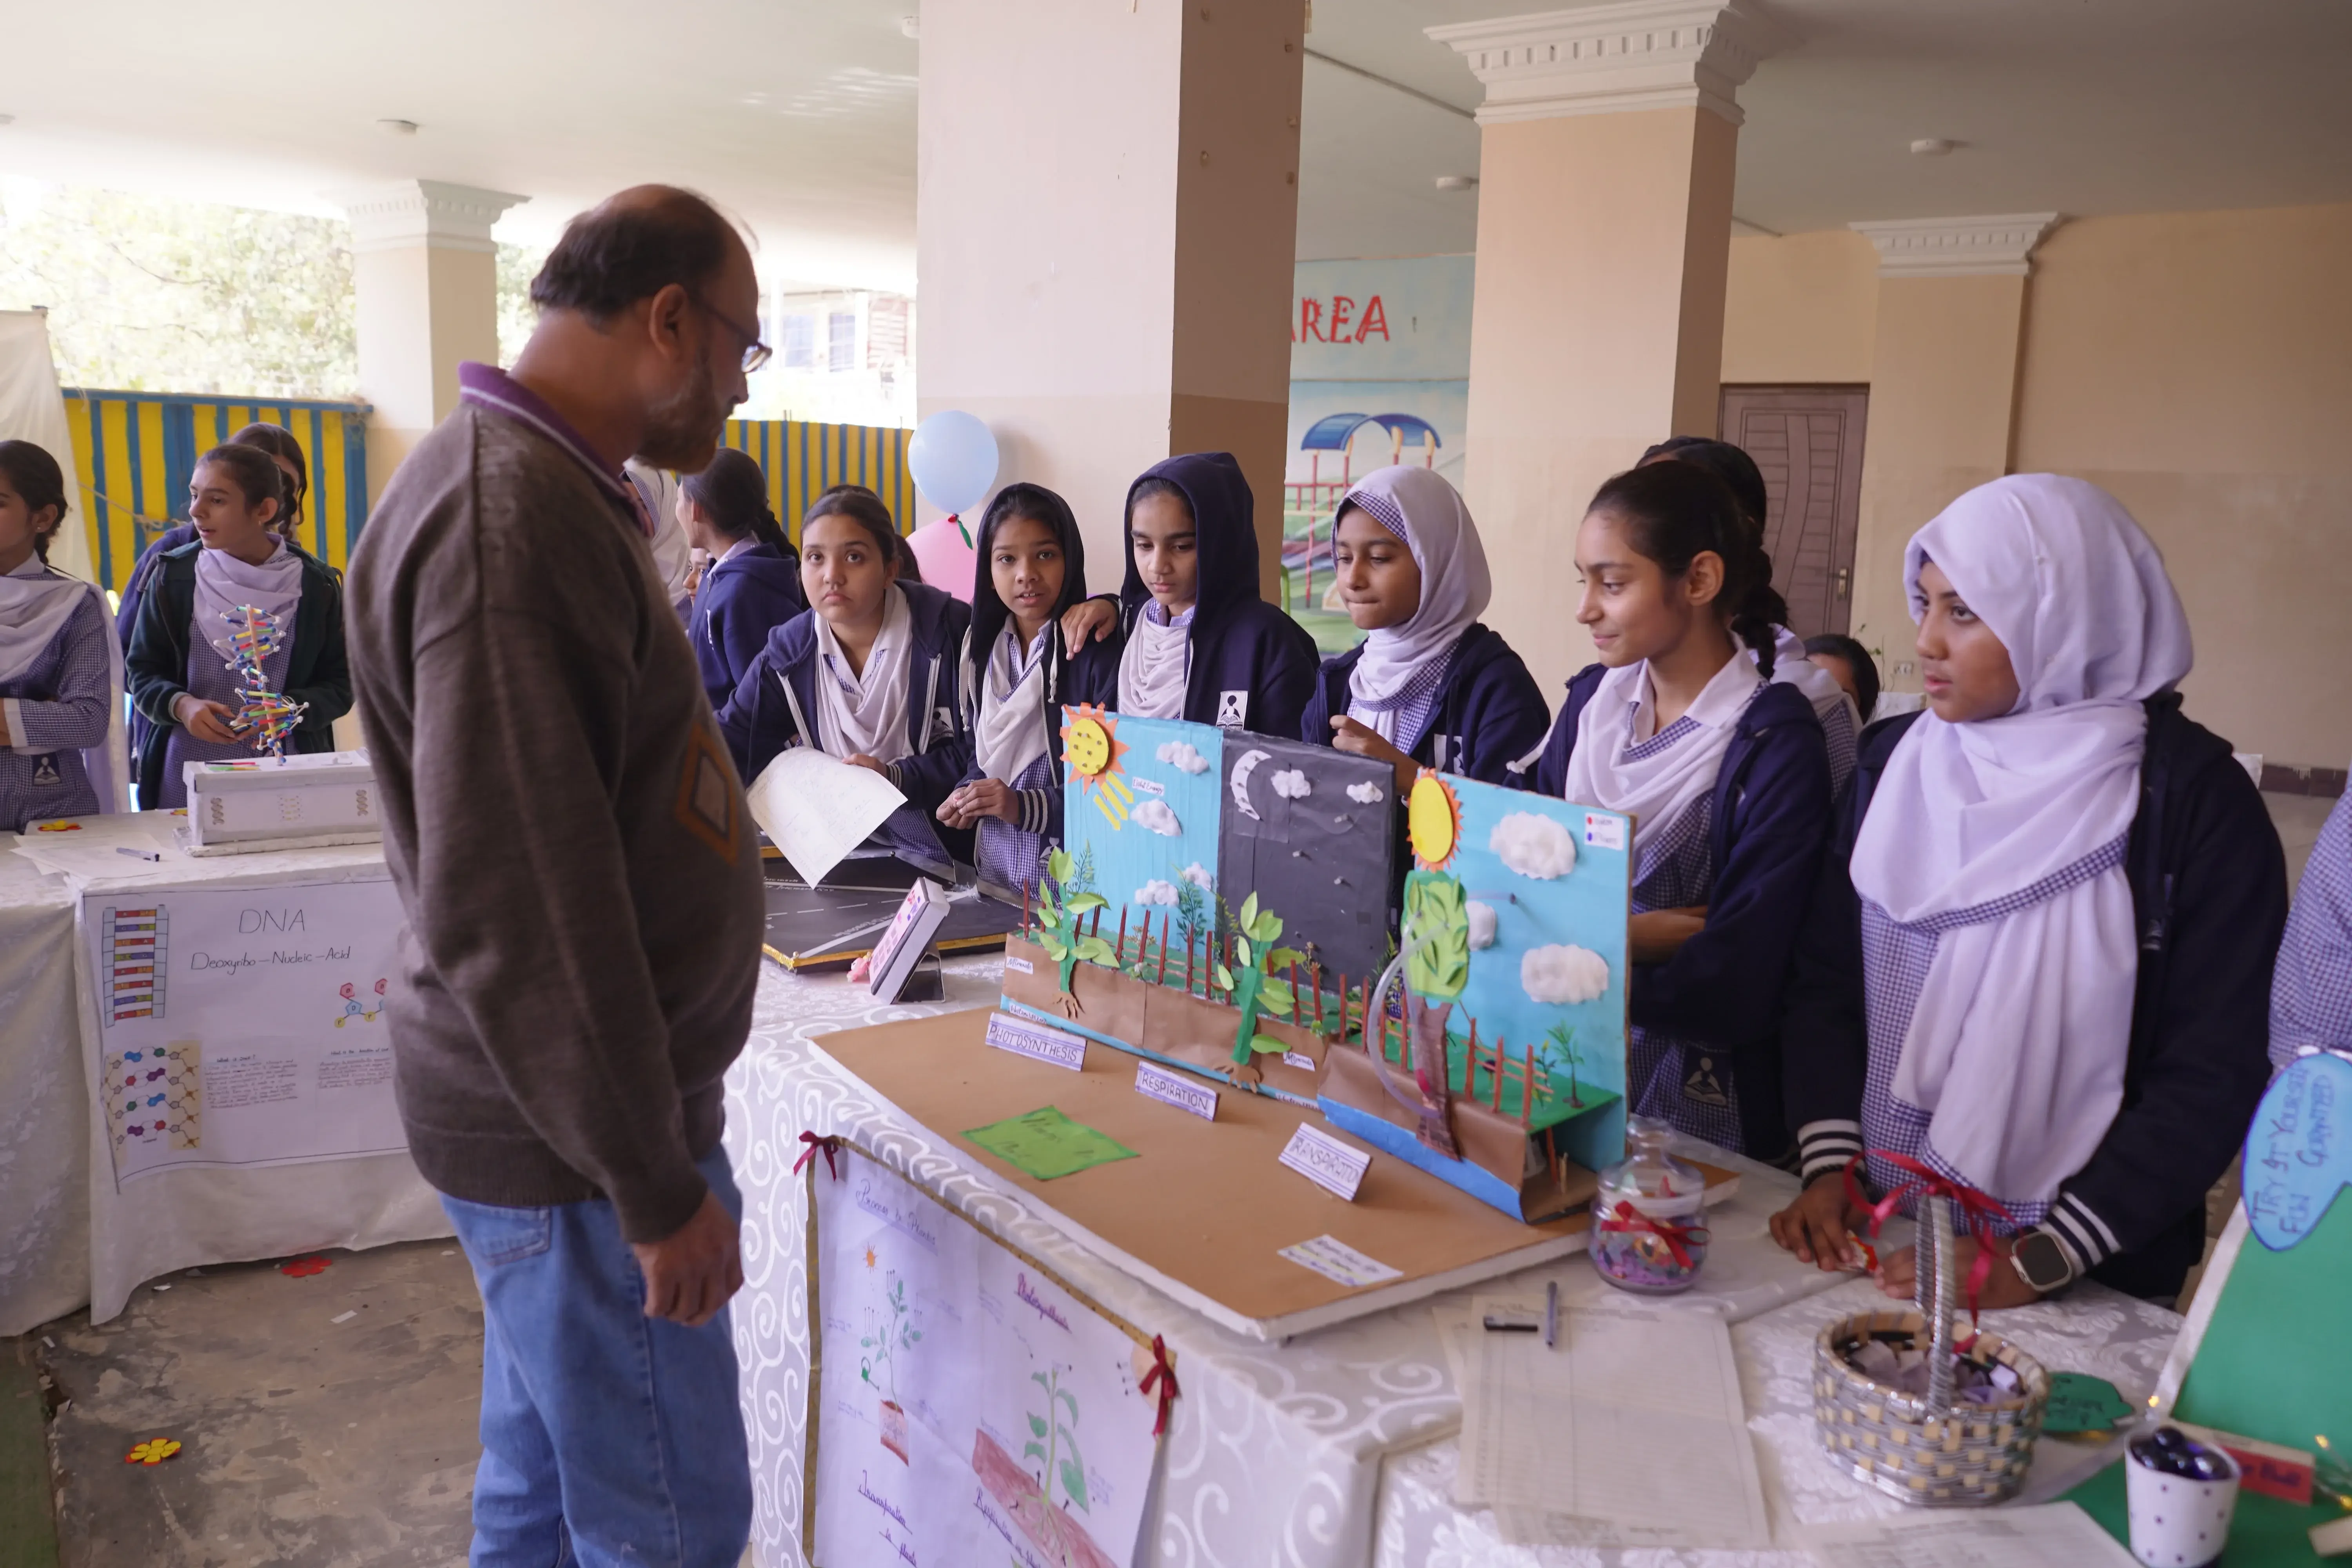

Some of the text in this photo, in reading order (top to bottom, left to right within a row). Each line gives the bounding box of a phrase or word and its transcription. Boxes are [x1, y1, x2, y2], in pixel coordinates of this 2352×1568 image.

[1291, 295, 1390, 344] REA
[239, 909, 305, 933] DNA
[989, 1024, 1078, 1062] PHOTOSYNTHESIS
[1142, 1072, 1209, 1111] RESPIRATION
[1289, 1135, 1362, 1185] TRANSPIRATION
[2251, 1176, 2285, 1220] TRY
[2279, 1193, 2311, 1235] FUN
